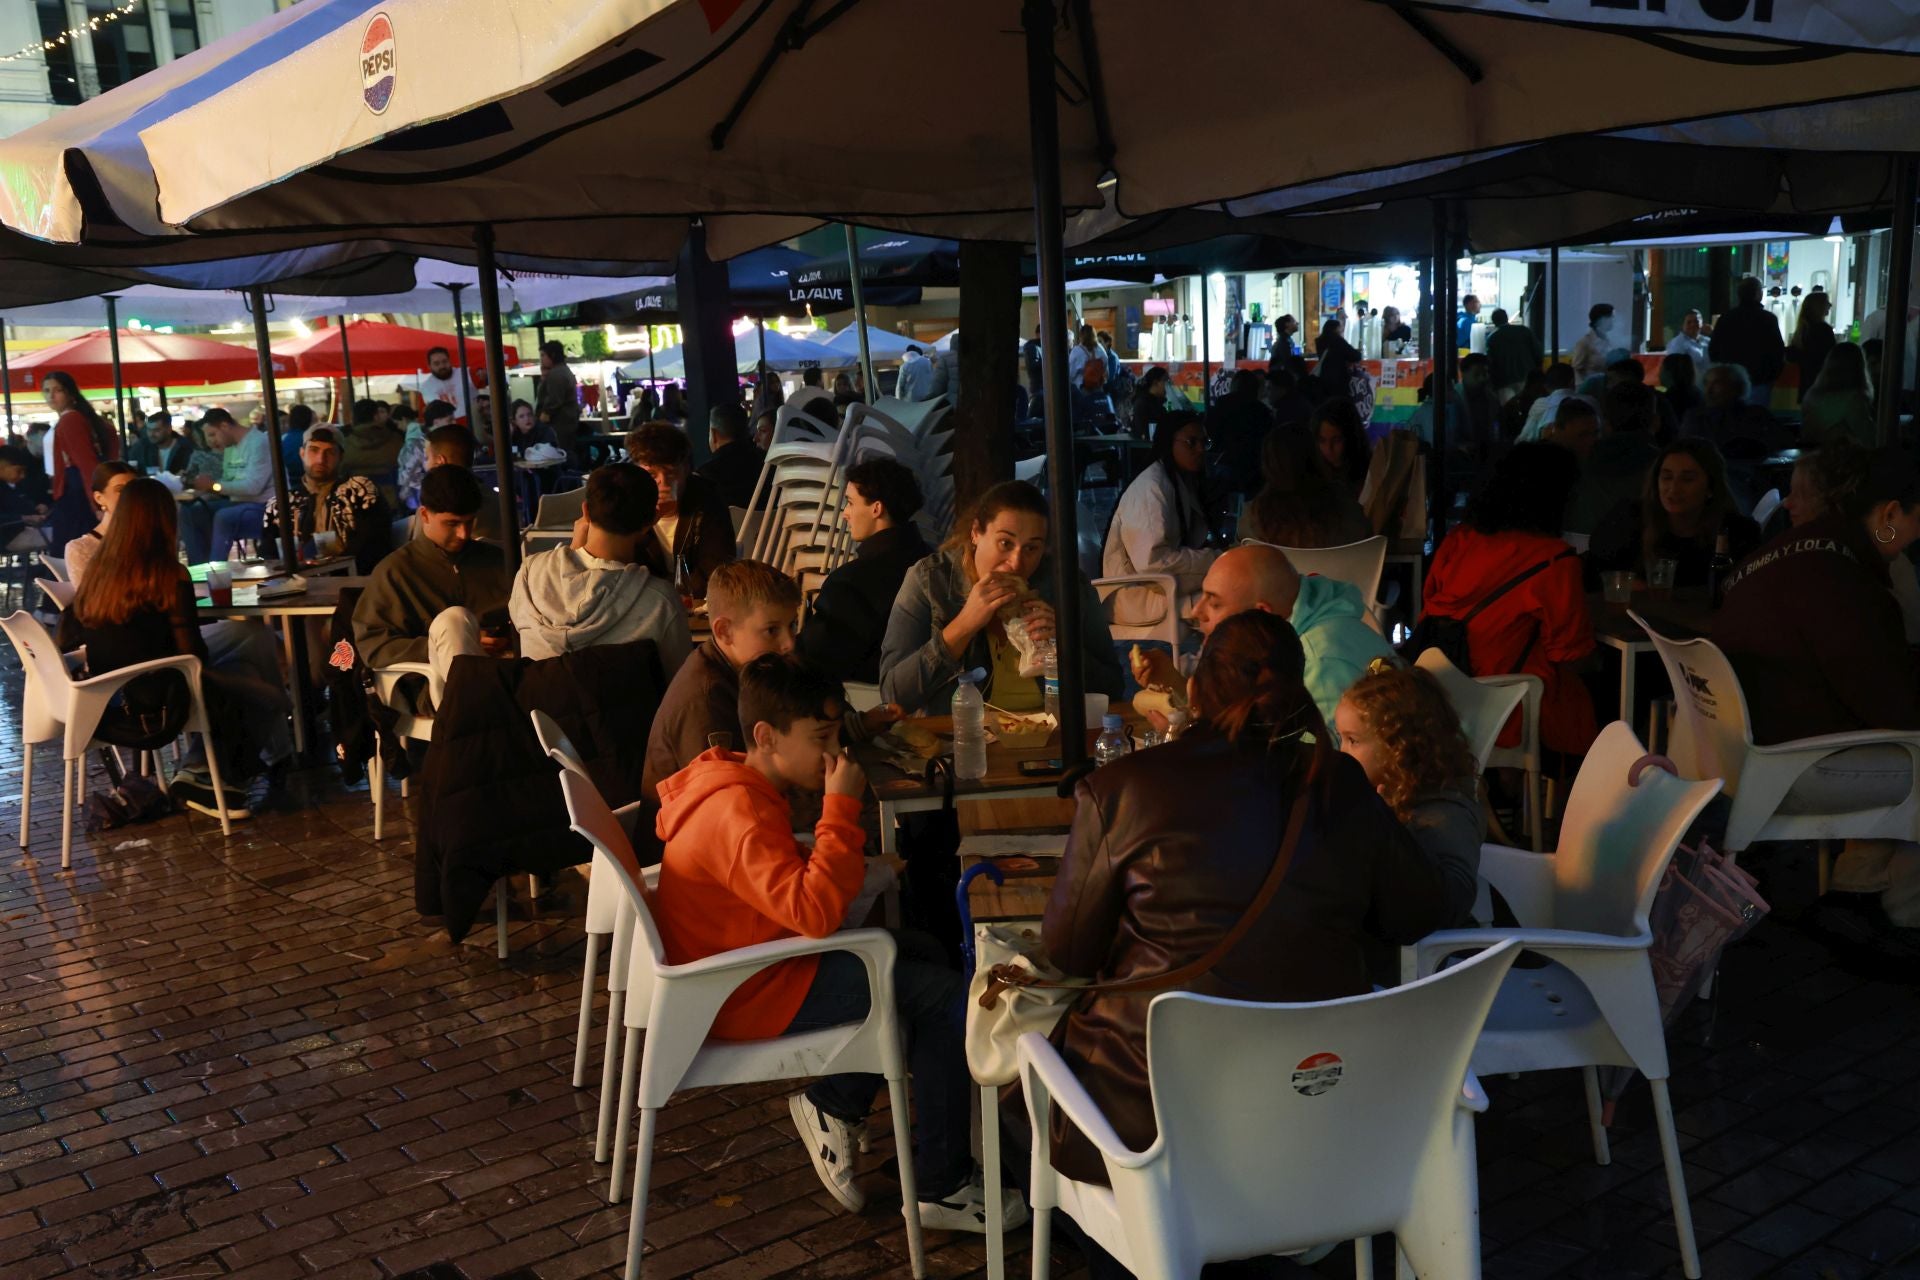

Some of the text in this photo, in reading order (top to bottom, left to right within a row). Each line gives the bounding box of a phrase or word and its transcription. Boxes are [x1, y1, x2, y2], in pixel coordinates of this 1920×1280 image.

[362, 48, 394, 79] PEPSI
[1745, 549, 1780, 576] BIMBA
[1782, 544, 1793, 557] Y
[1794, 538, 1837, 553] LOLA
